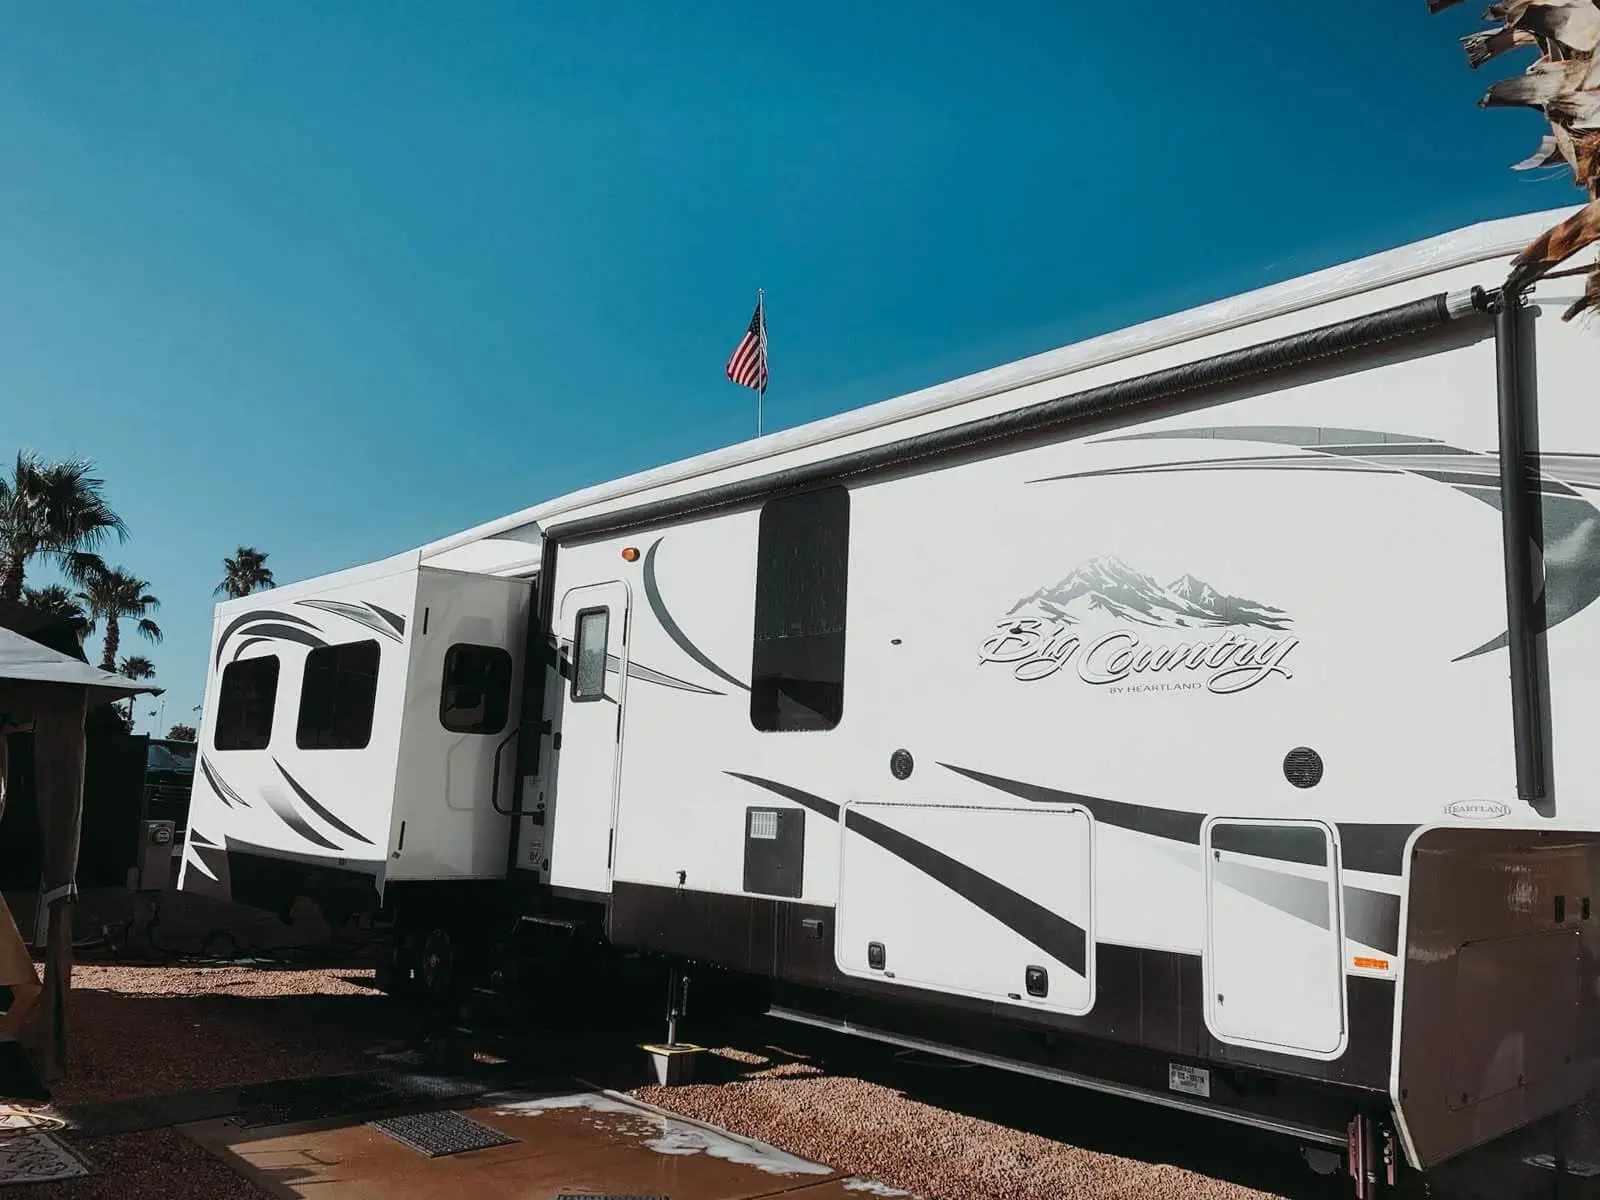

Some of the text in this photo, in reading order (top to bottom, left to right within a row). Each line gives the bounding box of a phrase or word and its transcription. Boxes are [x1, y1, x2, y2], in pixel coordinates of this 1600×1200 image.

[977, 615, 1300, 694] Big Country
[1127, 683, 1202, 693] HEARTLAND
